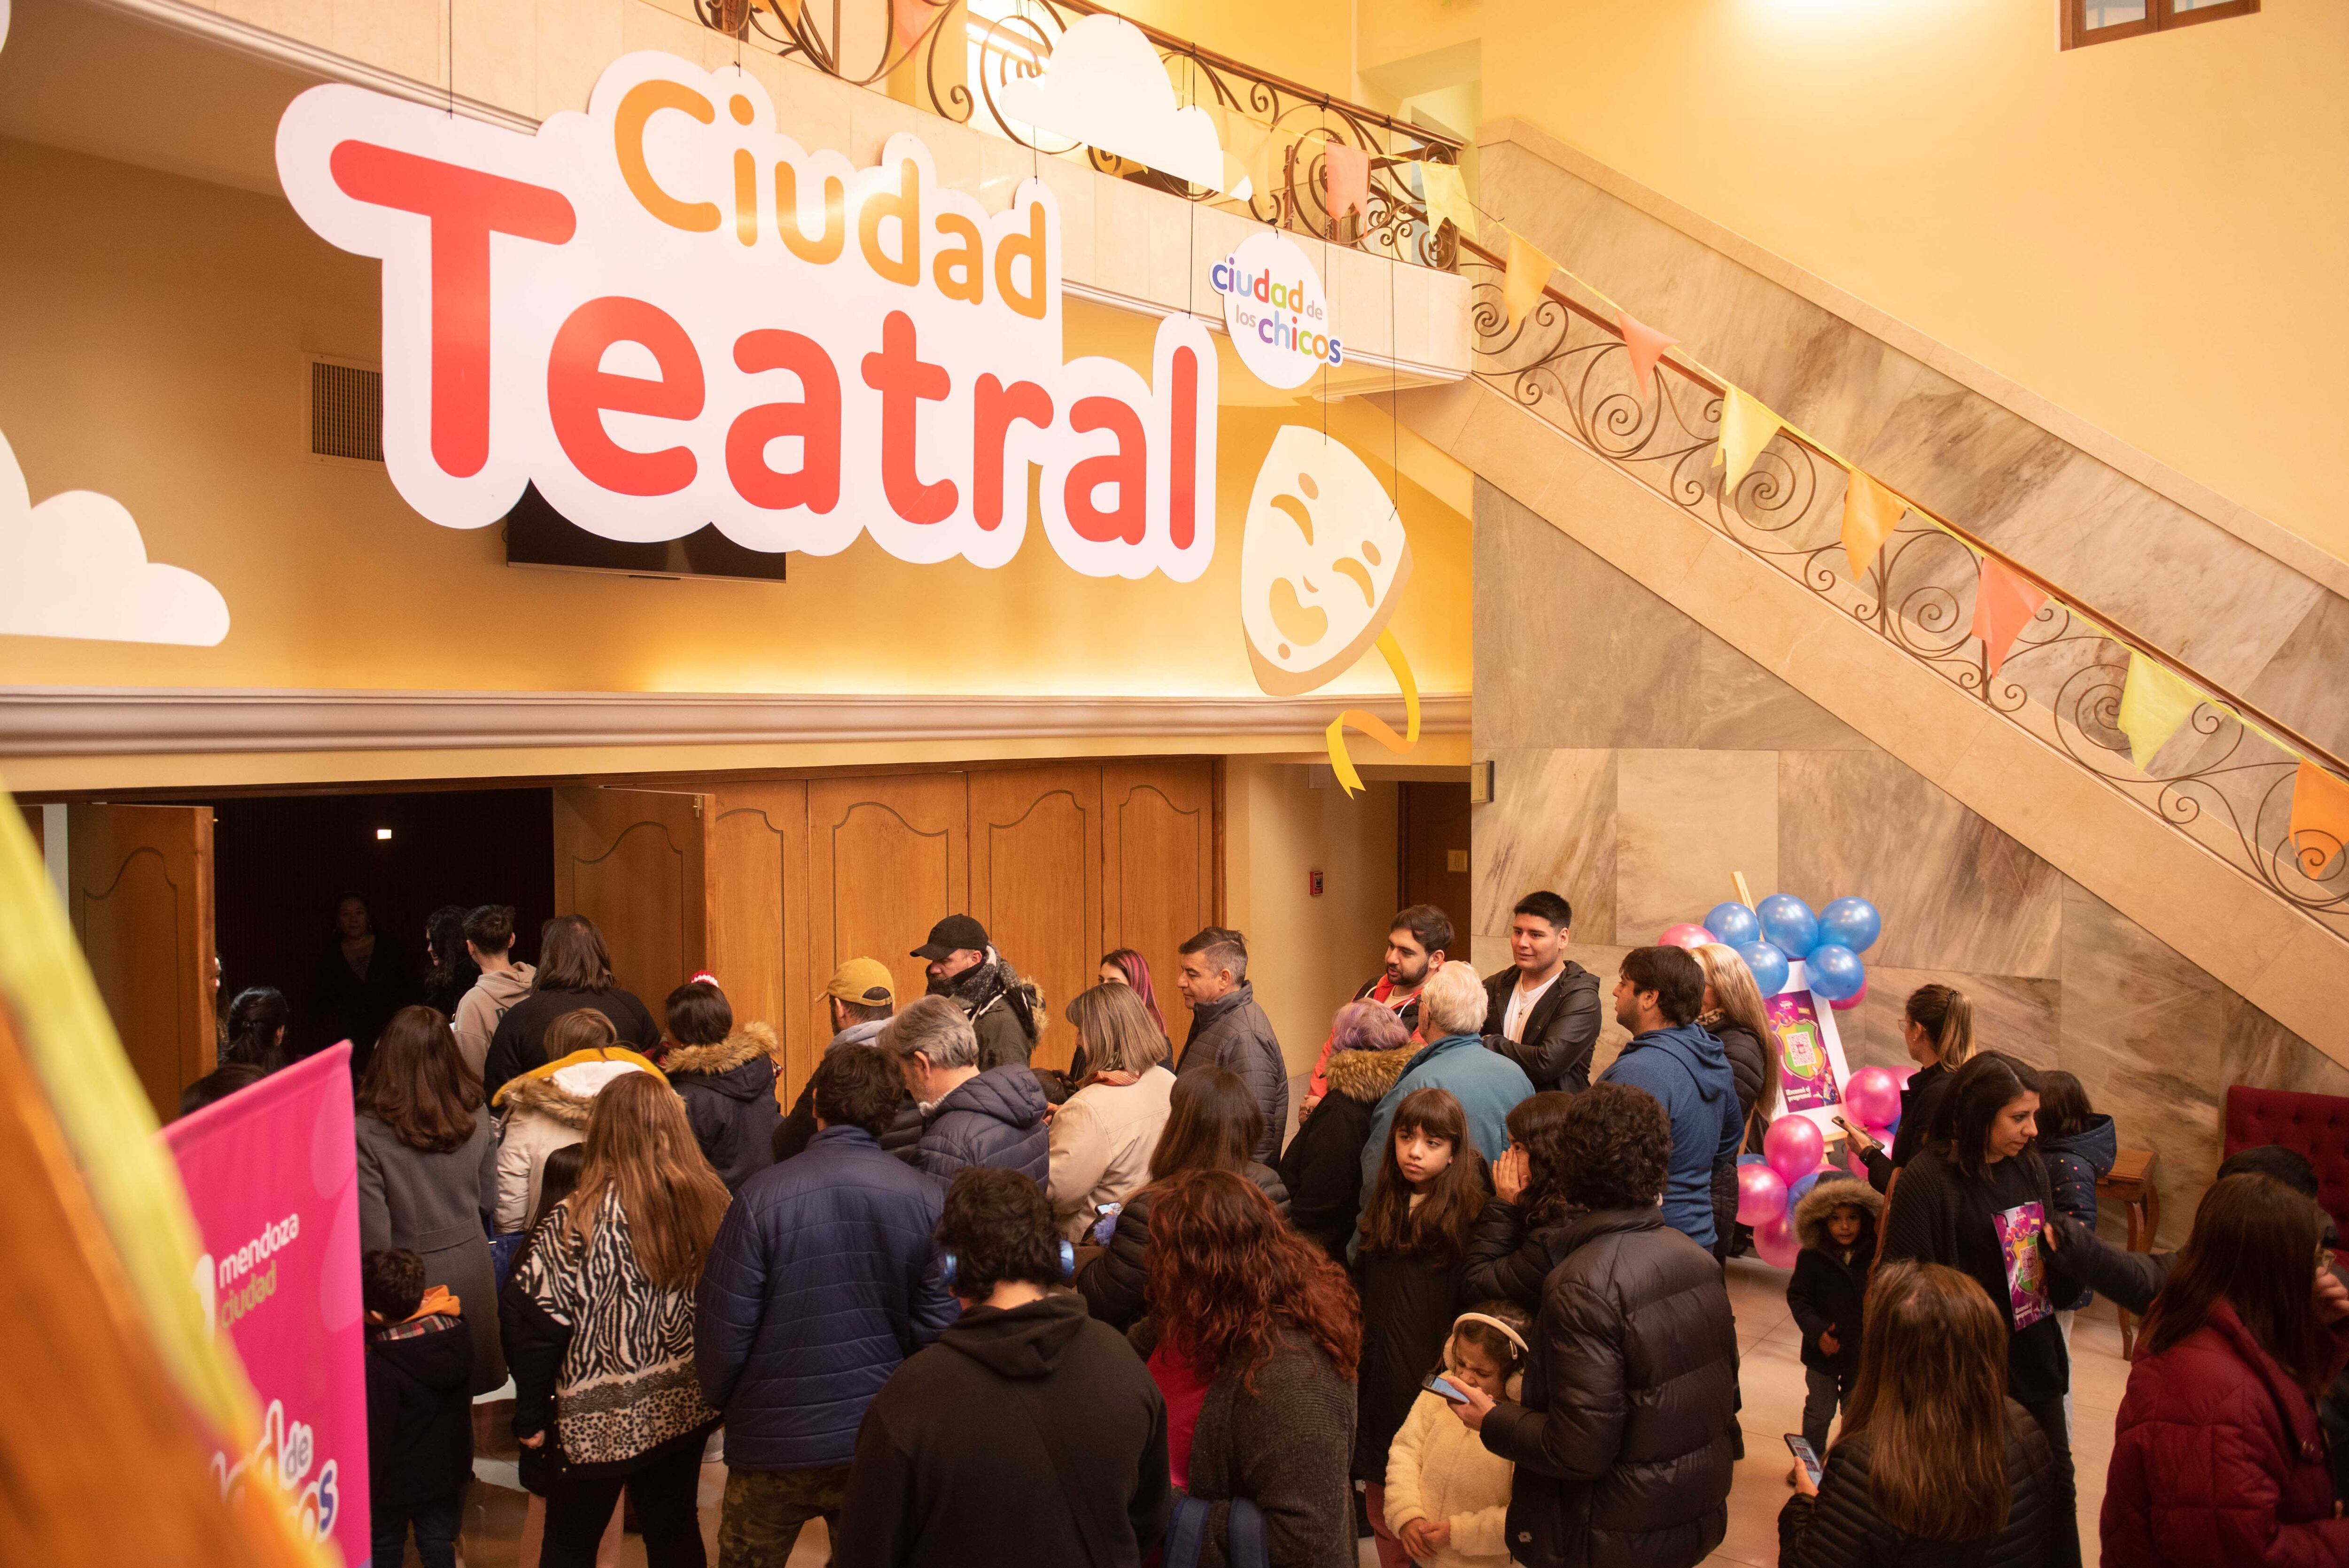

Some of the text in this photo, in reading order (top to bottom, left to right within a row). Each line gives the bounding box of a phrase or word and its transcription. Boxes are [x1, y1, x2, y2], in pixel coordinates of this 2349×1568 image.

[614, 79, 1047, 320] Ciudad
[1212, 256, 1323, 321] ciudad de
[329, 139, 1198, 550] Teatral
[1236, 303, 1341, 364] los chicos
[219, 1213, 300, 1289] mendoza
[220, 1259, 277, 1329] ciudad
[285, 1432, 310, 1481] de
